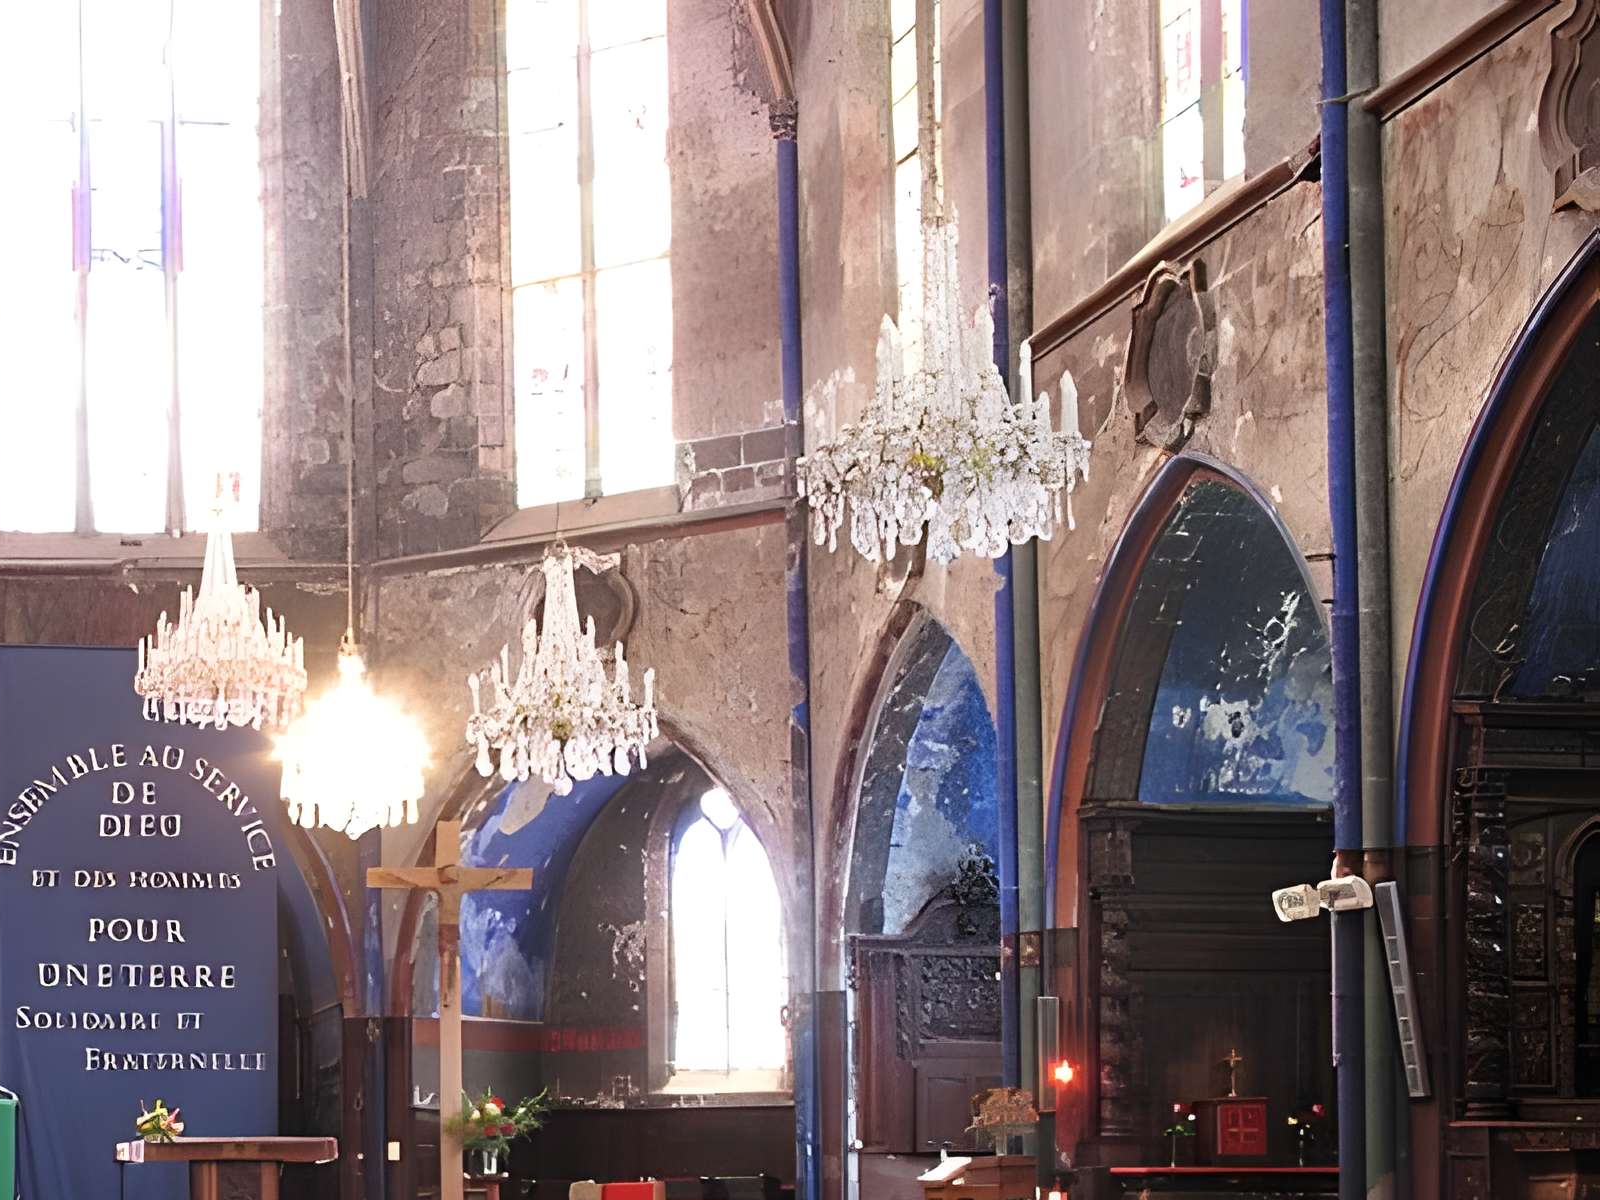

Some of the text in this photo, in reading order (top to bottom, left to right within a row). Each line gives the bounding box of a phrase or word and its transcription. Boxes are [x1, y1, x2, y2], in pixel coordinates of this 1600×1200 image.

[111, 781, 157, 805] DE
[139, 745, 185, 770] AU
[189, 758, 277, 871] SERVICE
[99, 813, 182, 838] DIEU
[31, 869, 61, 888] ET
[88, 918, 186, 943] POUR
[38, 962, 236, 989] UNE TERRE
